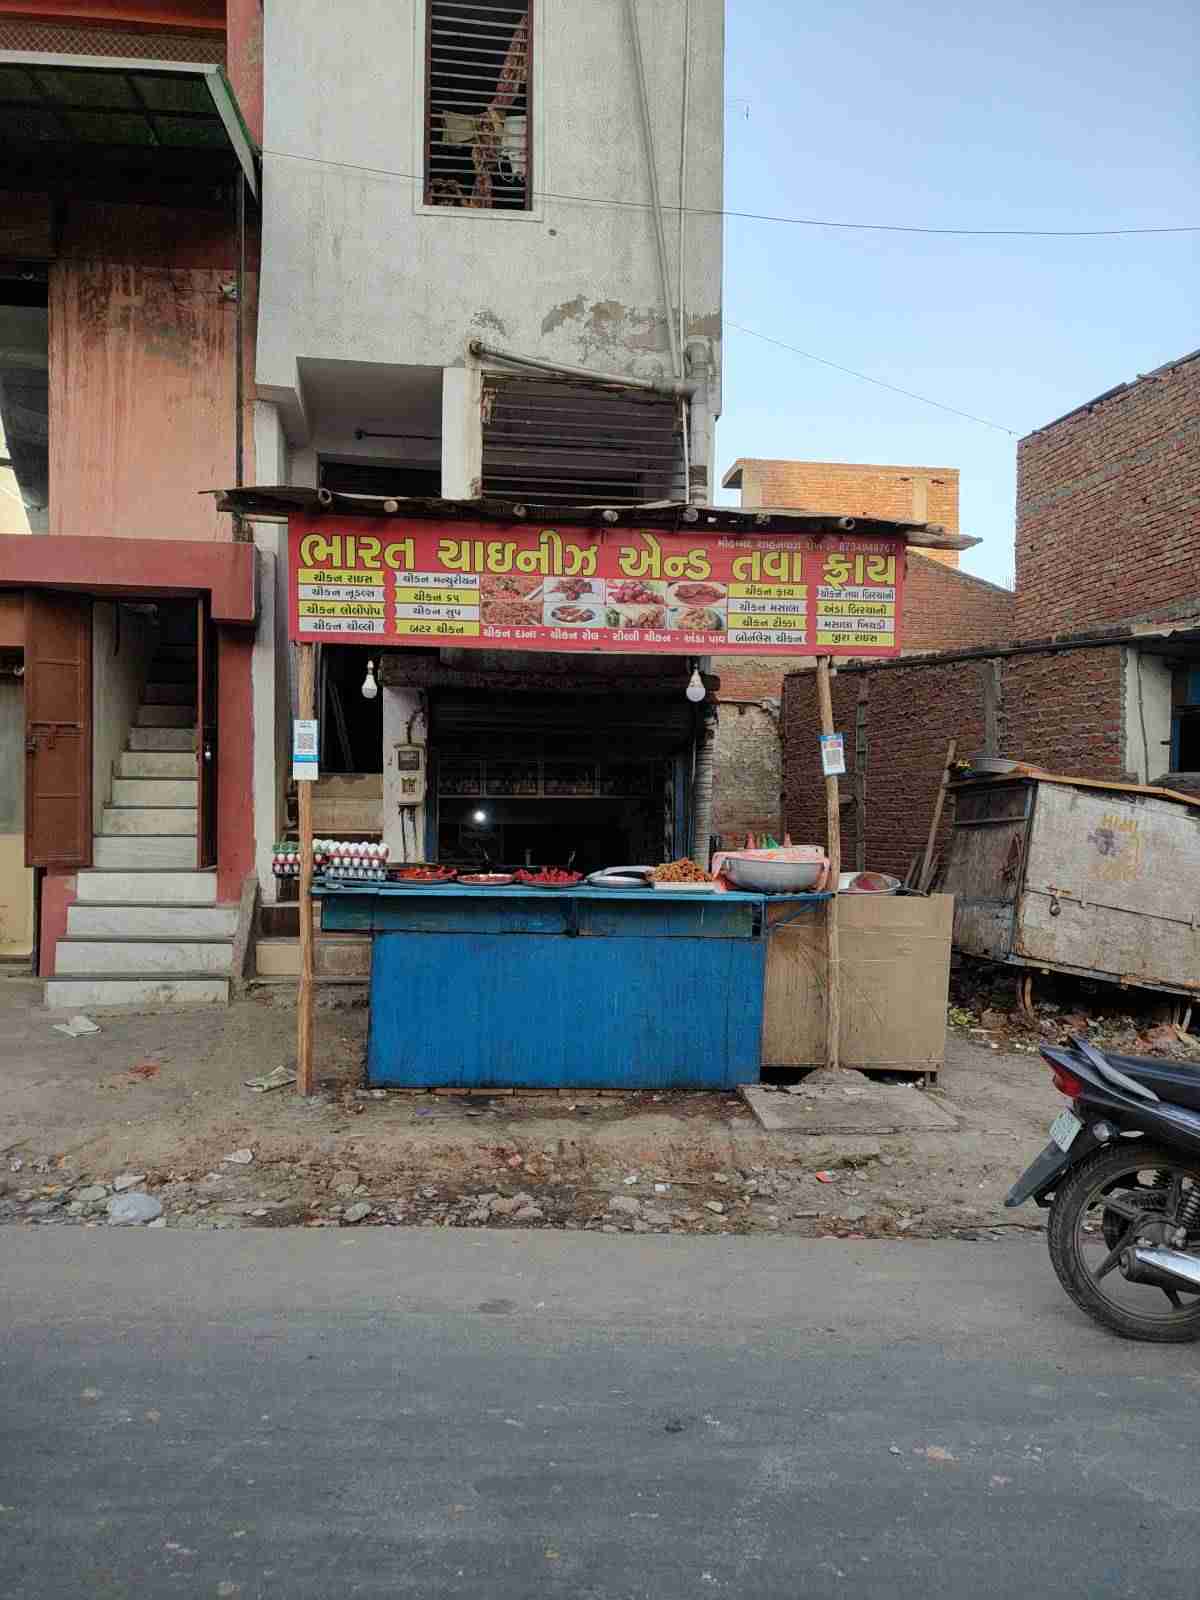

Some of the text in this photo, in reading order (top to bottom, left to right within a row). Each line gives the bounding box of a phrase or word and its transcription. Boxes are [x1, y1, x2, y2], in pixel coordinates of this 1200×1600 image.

[300, 533, 417, 570] ભારત
[437, 529, 598, 576] ચાઇનીઝ
[618, 531, 712, 580] એન્ડ
[731, 550, 802, 582] તવા
